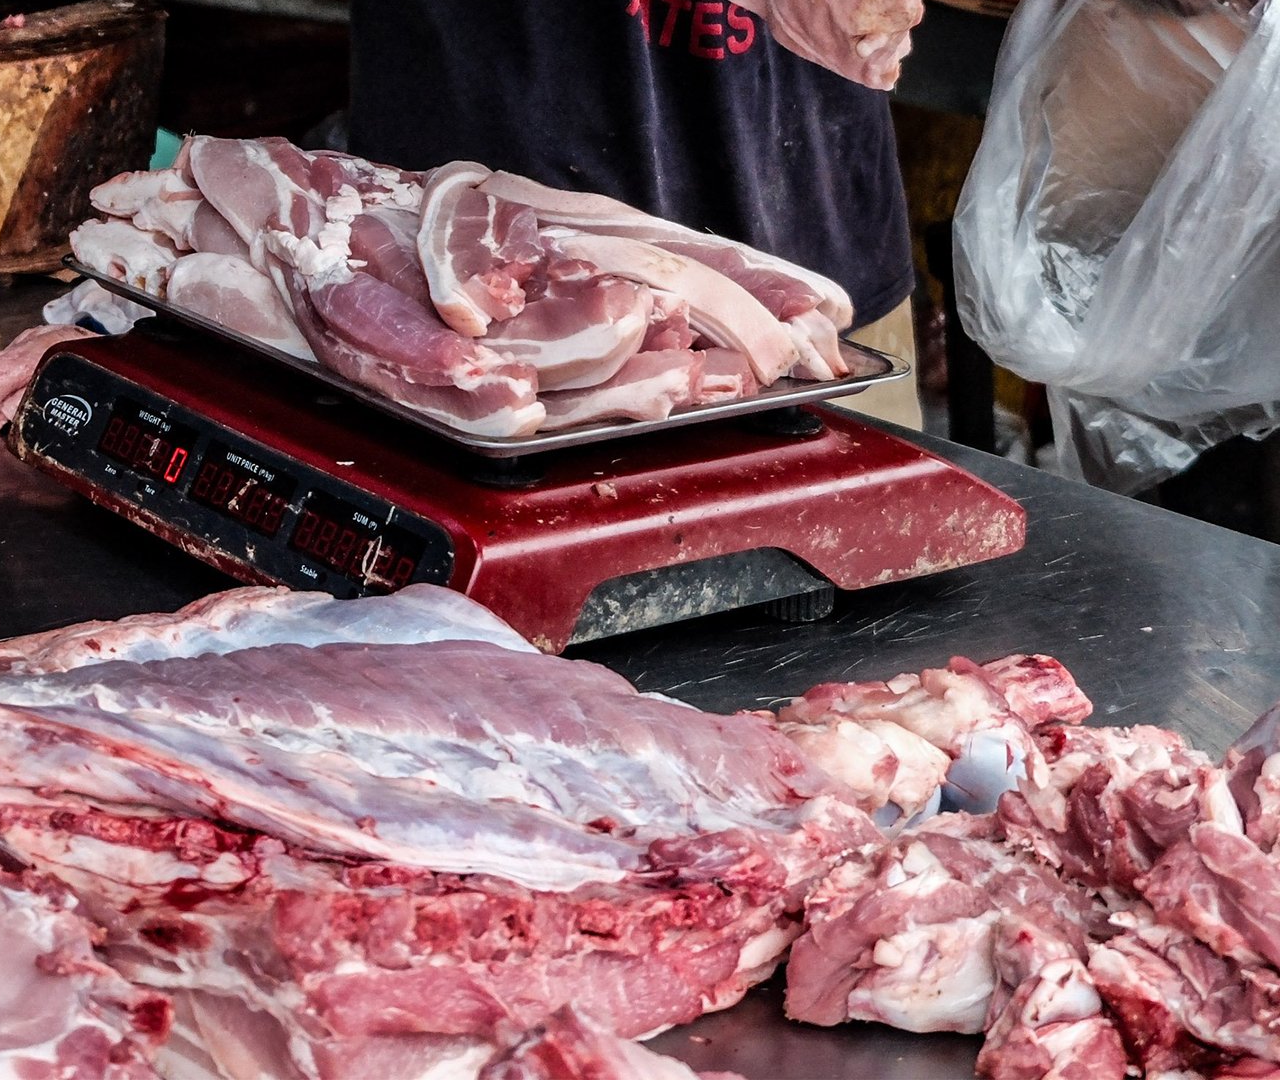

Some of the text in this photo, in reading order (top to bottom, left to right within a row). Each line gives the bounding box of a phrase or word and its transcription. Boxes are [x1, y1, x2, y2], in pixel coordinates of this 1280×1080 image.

[50, 408, 81, 428] MASTER
[51, 397, 89, 422] GENERAL
[138, 409, 162, 427] WEIGHT
[104, 463, 117, 476] Zero
[226, 451, 242, 467] UNIT
[240, 458, 260, 475] PRICE
[143, 483, 156, 496] Tare
[351, 511, 370, 528] SUM
[299, 563, 319, 580] Stable
